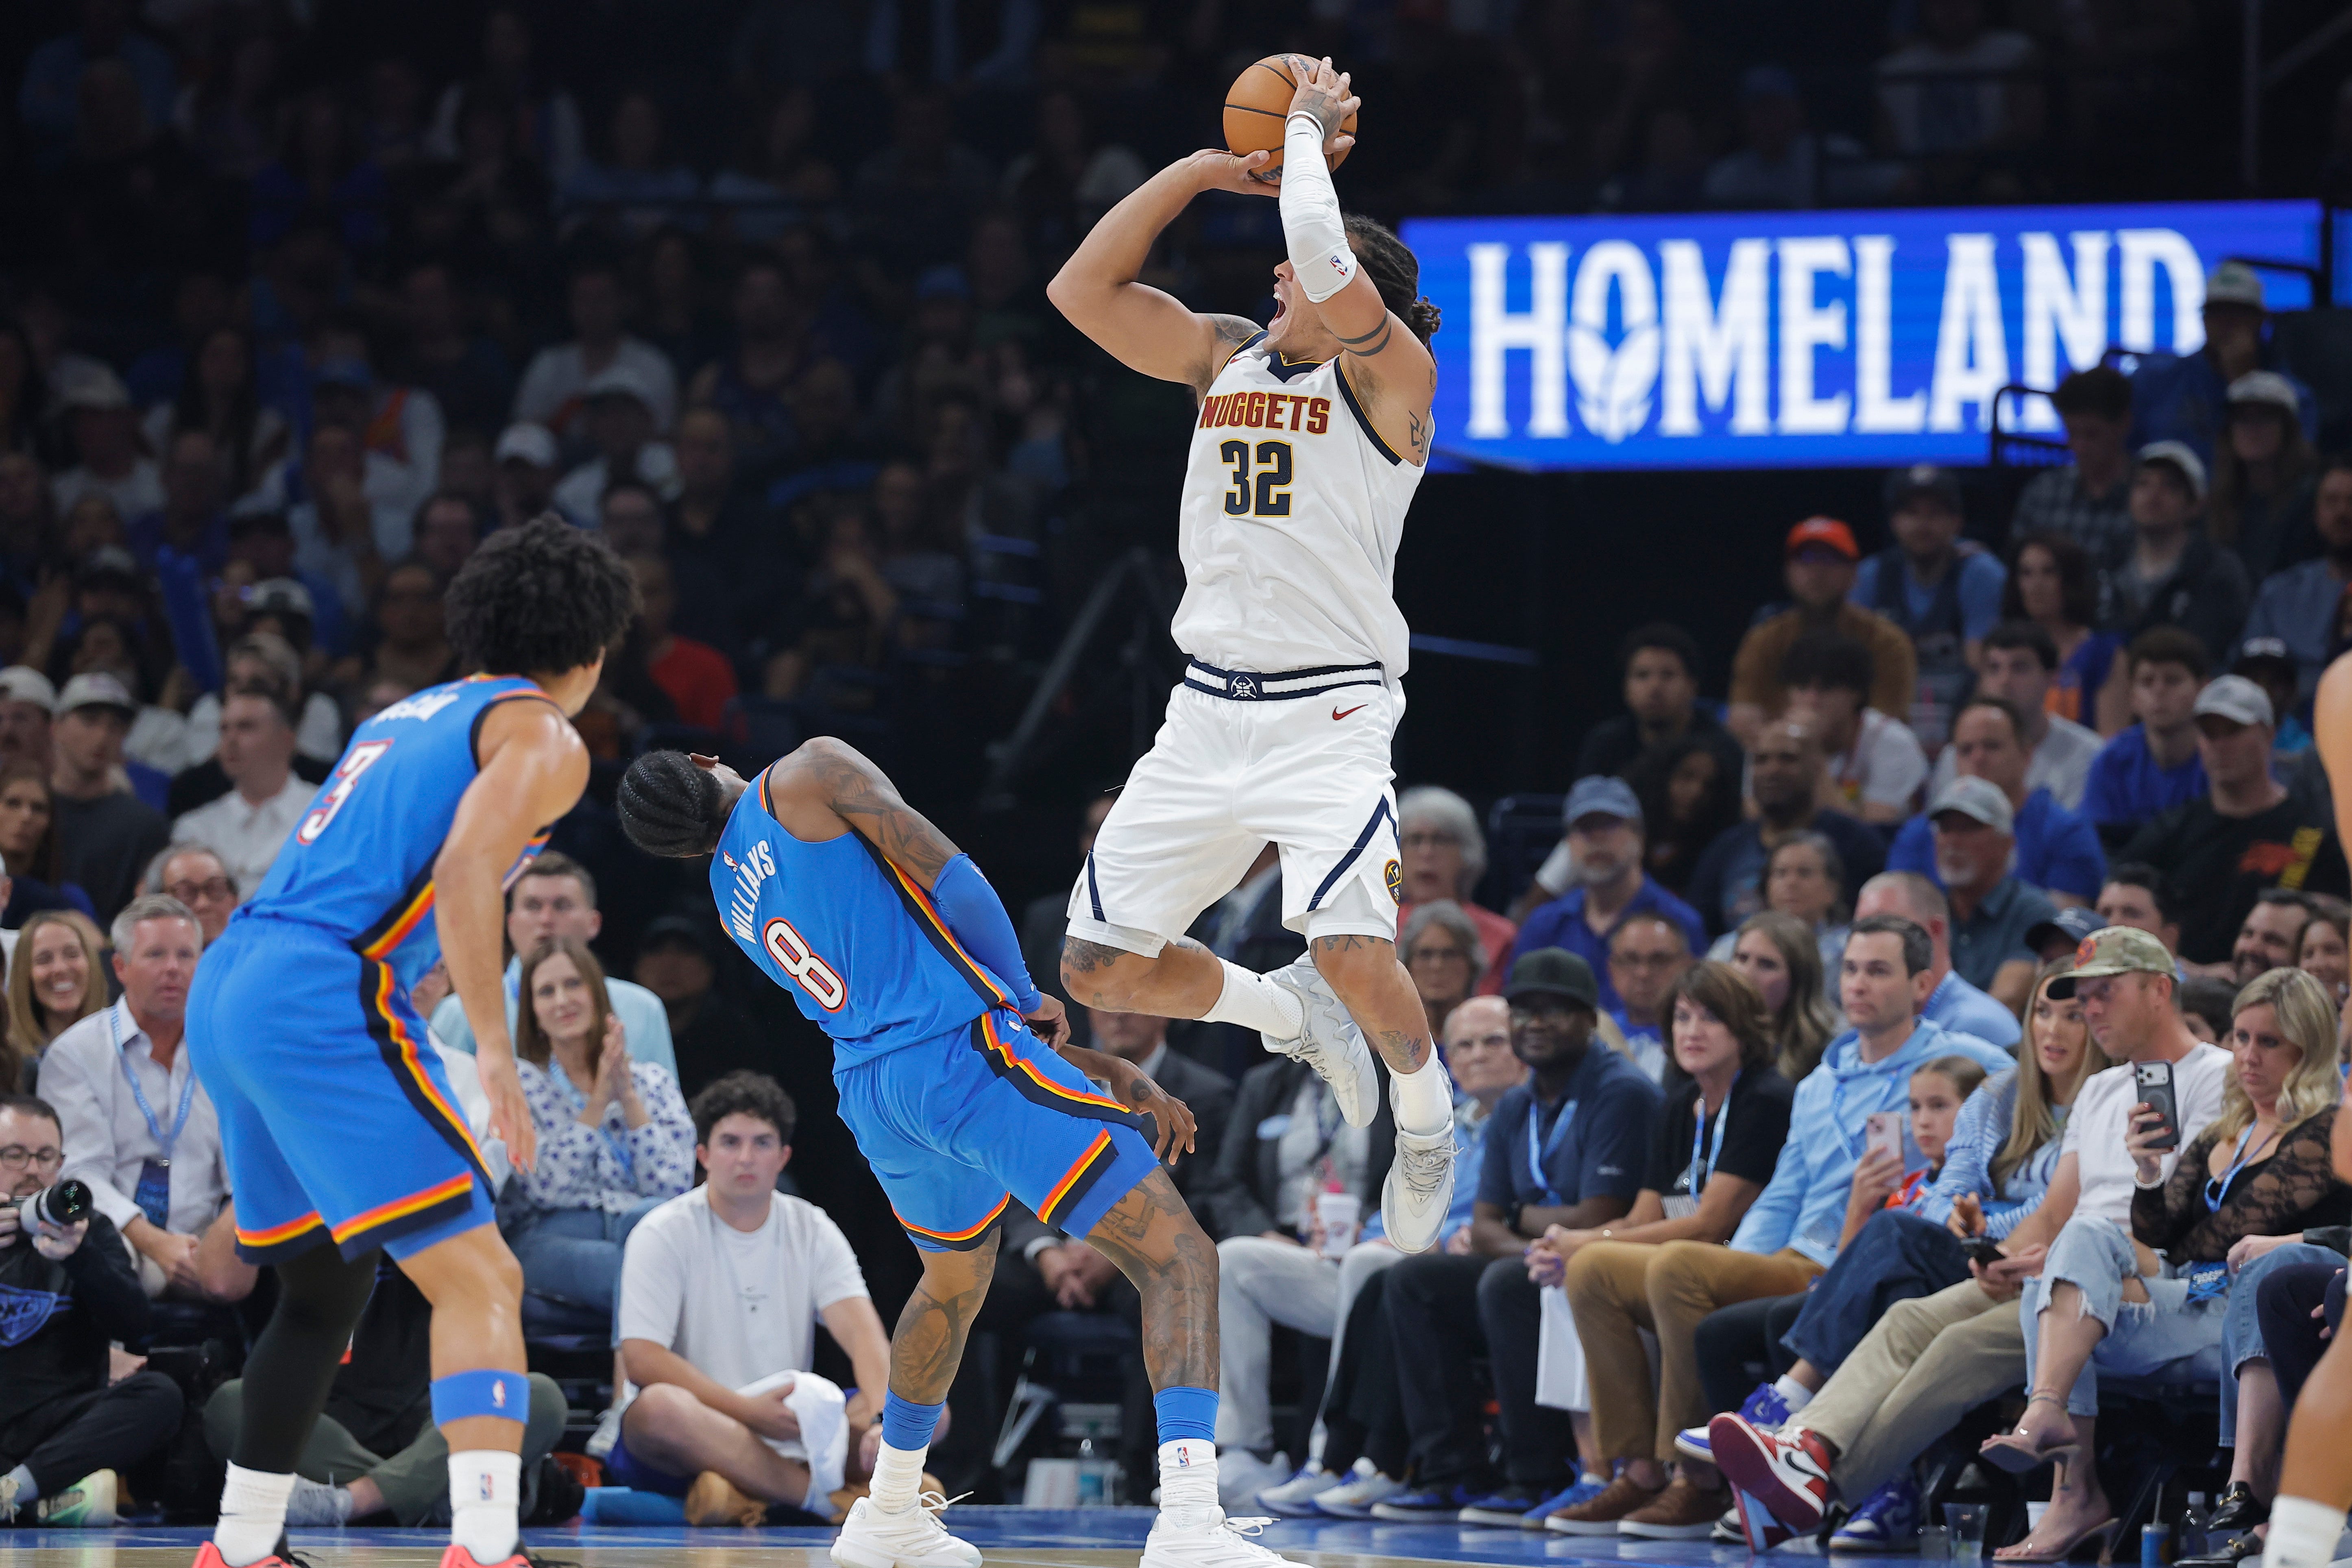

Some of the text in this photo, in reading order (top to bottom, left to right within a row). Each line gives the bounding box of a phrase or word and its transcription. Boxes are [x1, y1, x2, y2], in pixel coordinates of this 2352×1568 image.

[1467, 228, 2207, 443] HOMELAND
[1199, 392, 1331, 435] NUGGETS
[1220, 439, 1293, 517] 32
[298, 738, 394, 845] 3
[763, 917, 847, 1013] 8
